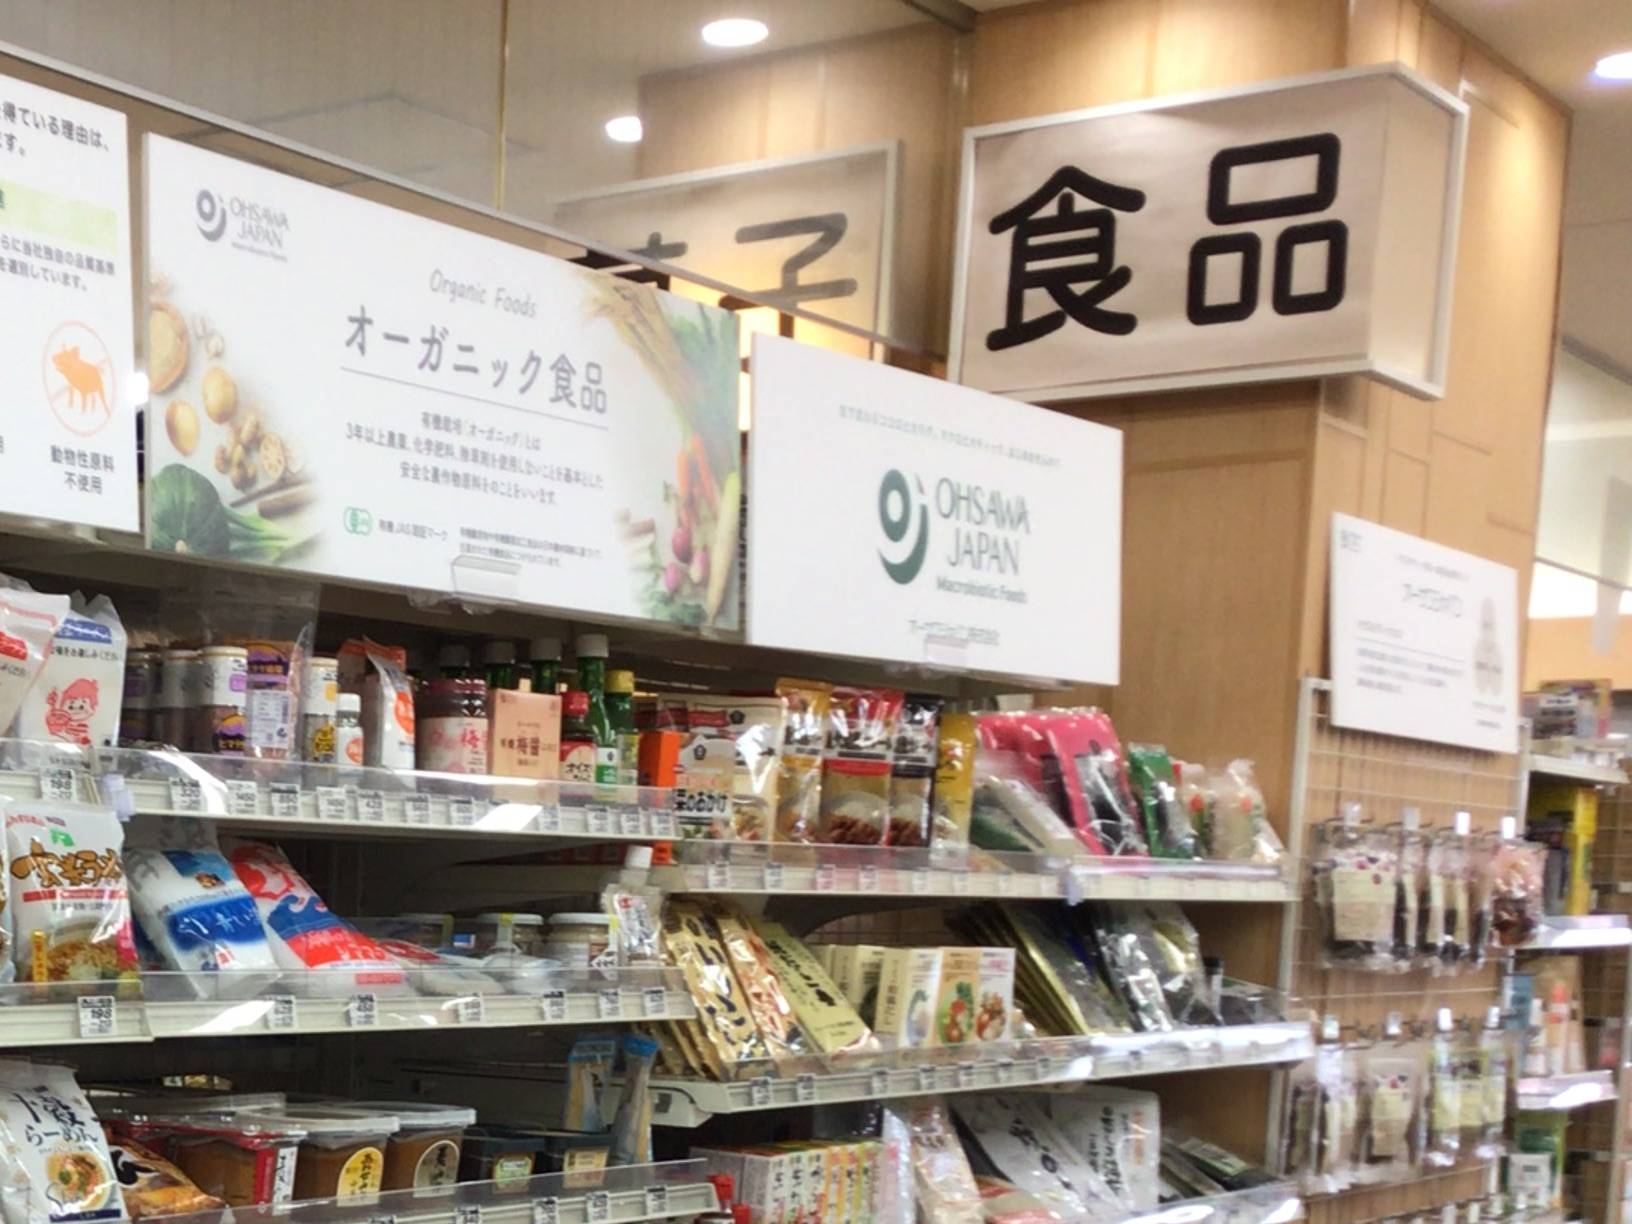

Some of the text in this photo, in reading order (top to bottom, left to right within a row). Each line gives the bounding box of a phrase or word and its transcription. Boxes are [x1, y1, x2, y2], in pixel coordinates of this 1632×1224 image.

[229, 196, 291, 231] OHSAWA
[236, 220, 284, 248] JAPAN
[984, 131, 1348, 352] 食品
[430, 269, 537, 319] Organic Foods
[344, 305, 608, 414] オーガニック食品
[51, 446, 115, 473] 動物性原料
[64, 473, 102, 495] 不使用
[935, 477, 1031, 536] OHSAWA
[947, 530, 1019, 576] JAPAN
